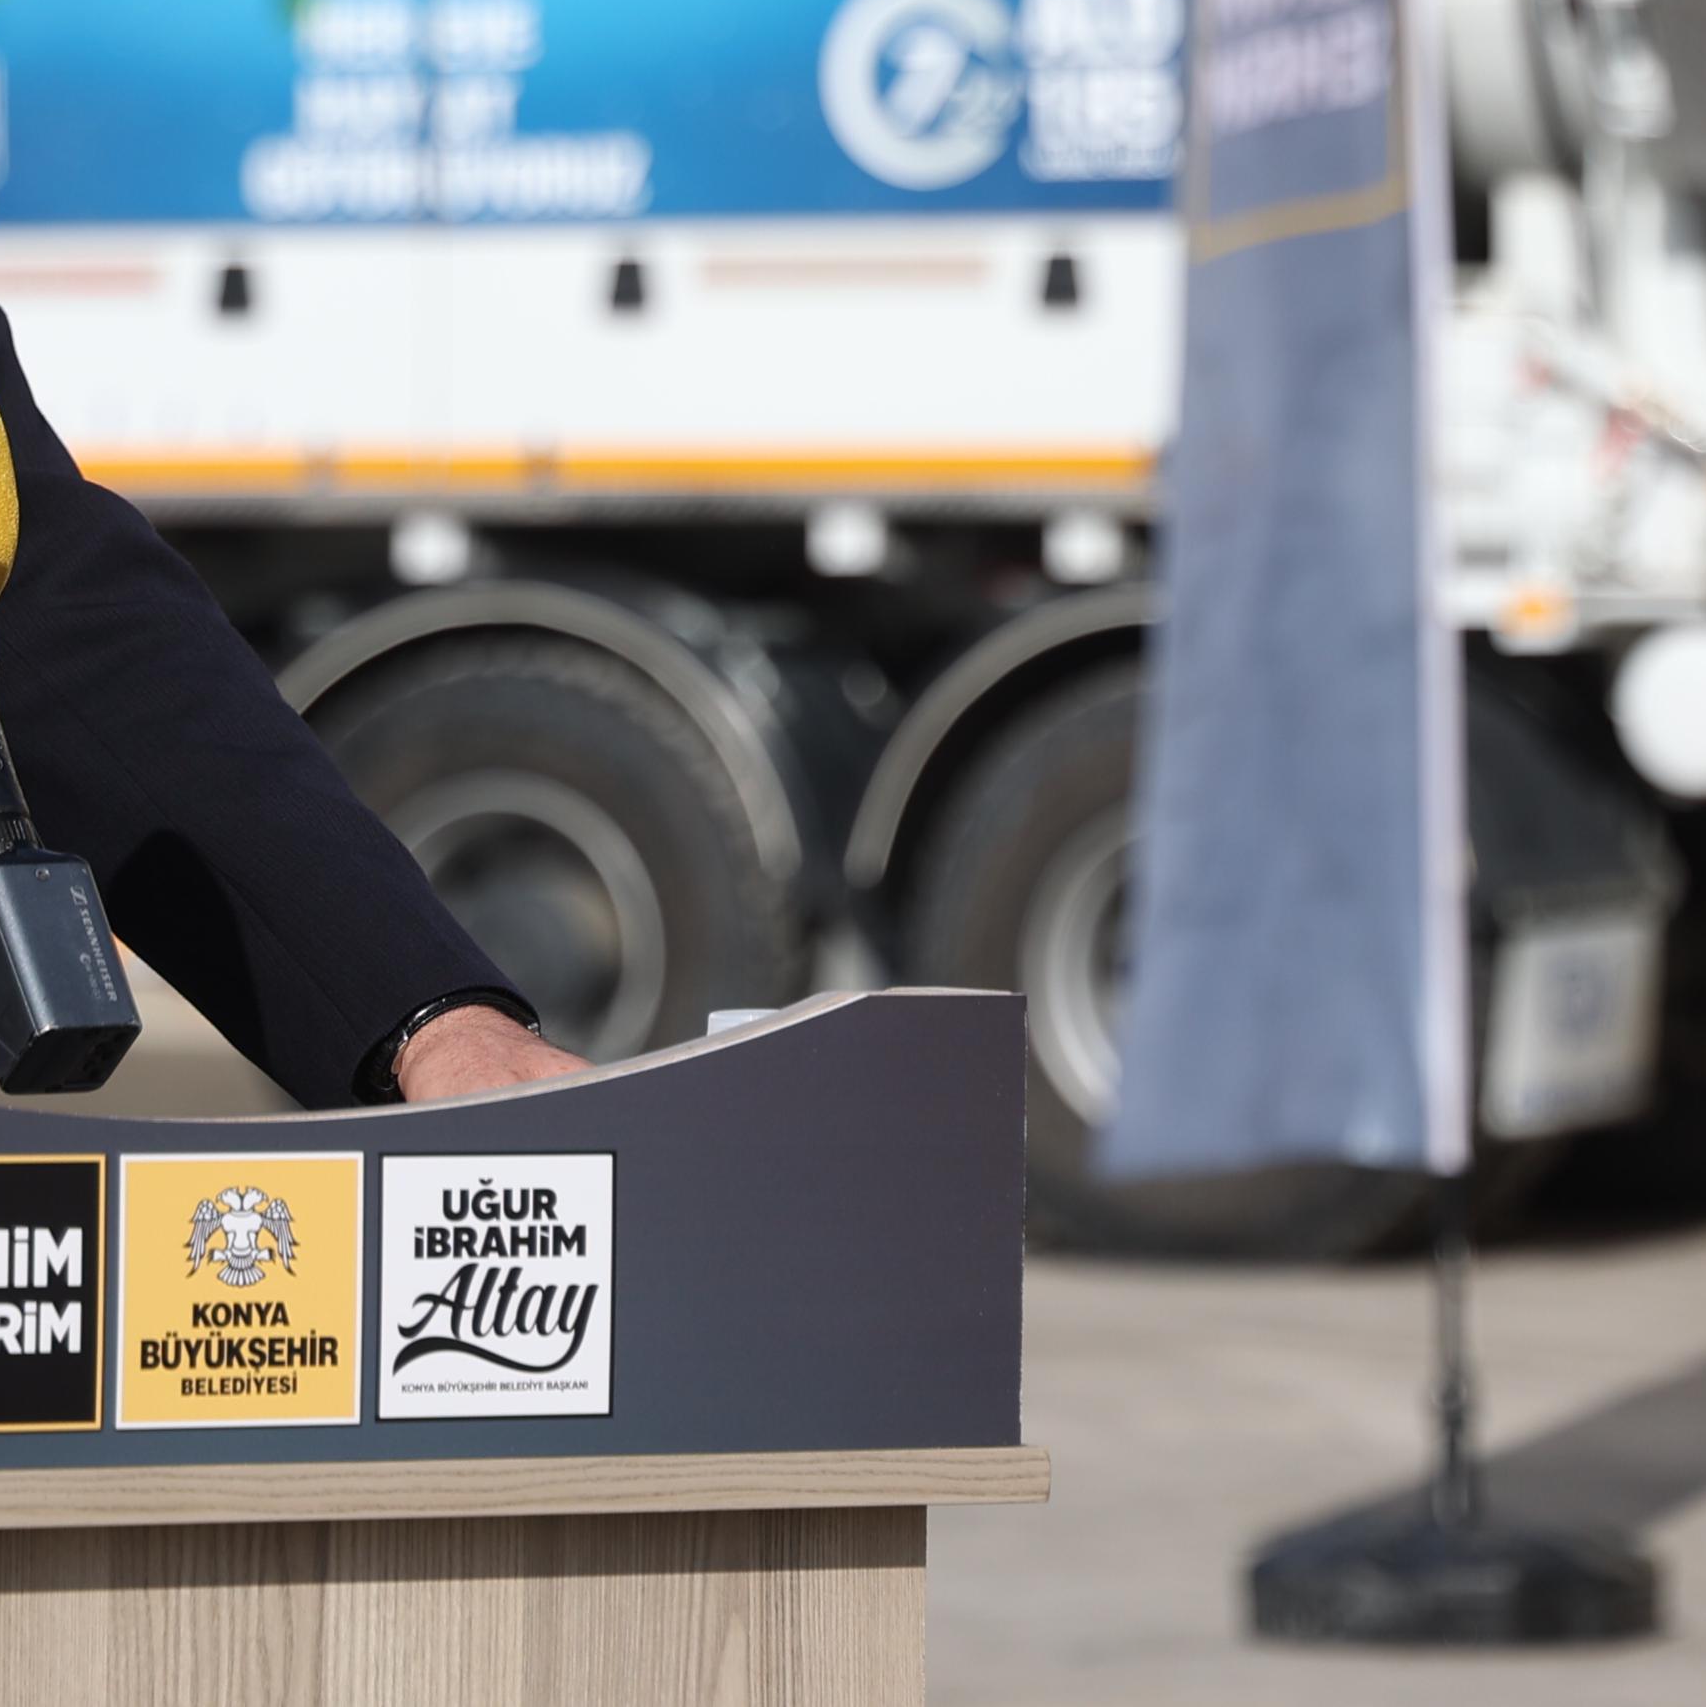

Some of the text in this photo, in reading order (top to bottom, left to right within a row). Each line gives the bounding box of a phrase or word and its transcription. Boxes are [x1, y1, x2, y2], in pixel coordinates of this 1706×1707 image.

[81, 907, 117, 1002] SENNHEISER
[442, 1178, 558, 1222] UĞUR
[413, 1224, 587, 1260] İBRAHİM
[191, 1301, 290, 1328] KONYA
[394, 1262, 599, 1374] Altay
[140, 1329, 339, 1373] BÜYÜKŞEHİR
[180, 1371, 298, 1396] BELEDİYESİ
[401, 1383, 435, 1394] KONYA
